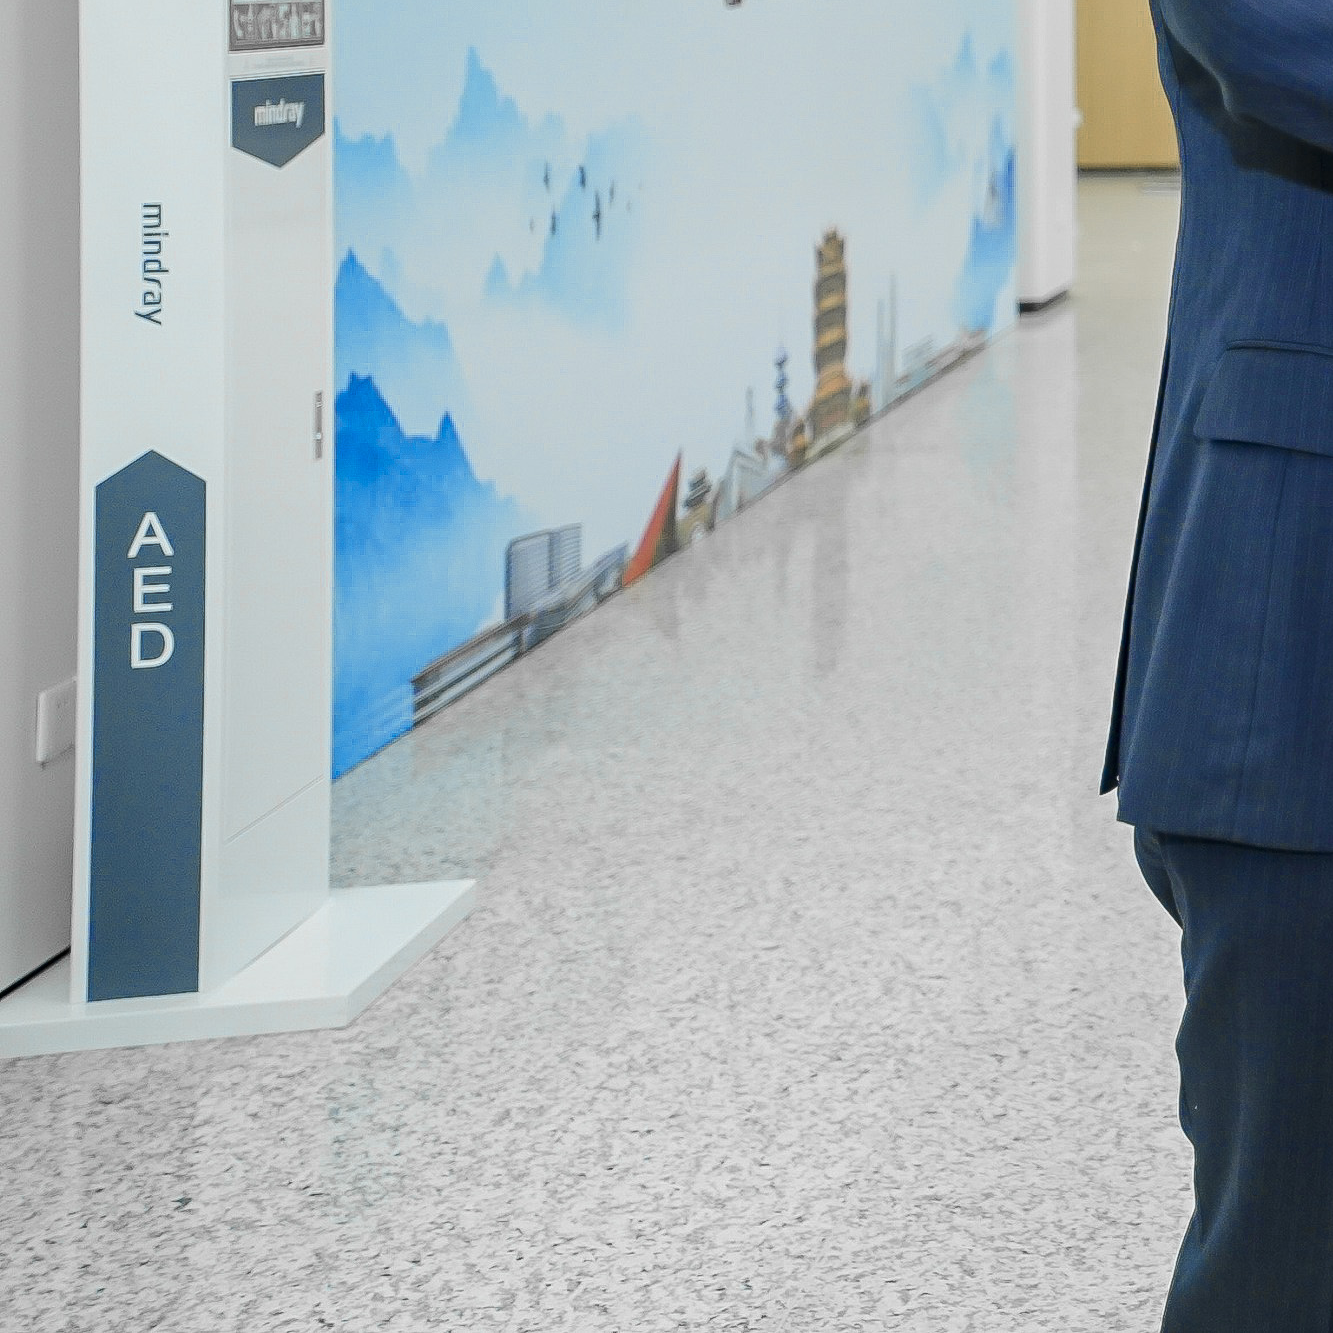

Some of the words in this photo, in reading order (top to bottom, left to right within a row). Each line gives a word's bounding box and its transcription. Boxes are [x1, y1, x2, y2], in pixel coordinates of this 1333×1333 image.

[254, 97, 305, 128] mindray
[134, 202, 169, 326] mindray
[127, 511, 175, 669] AED
